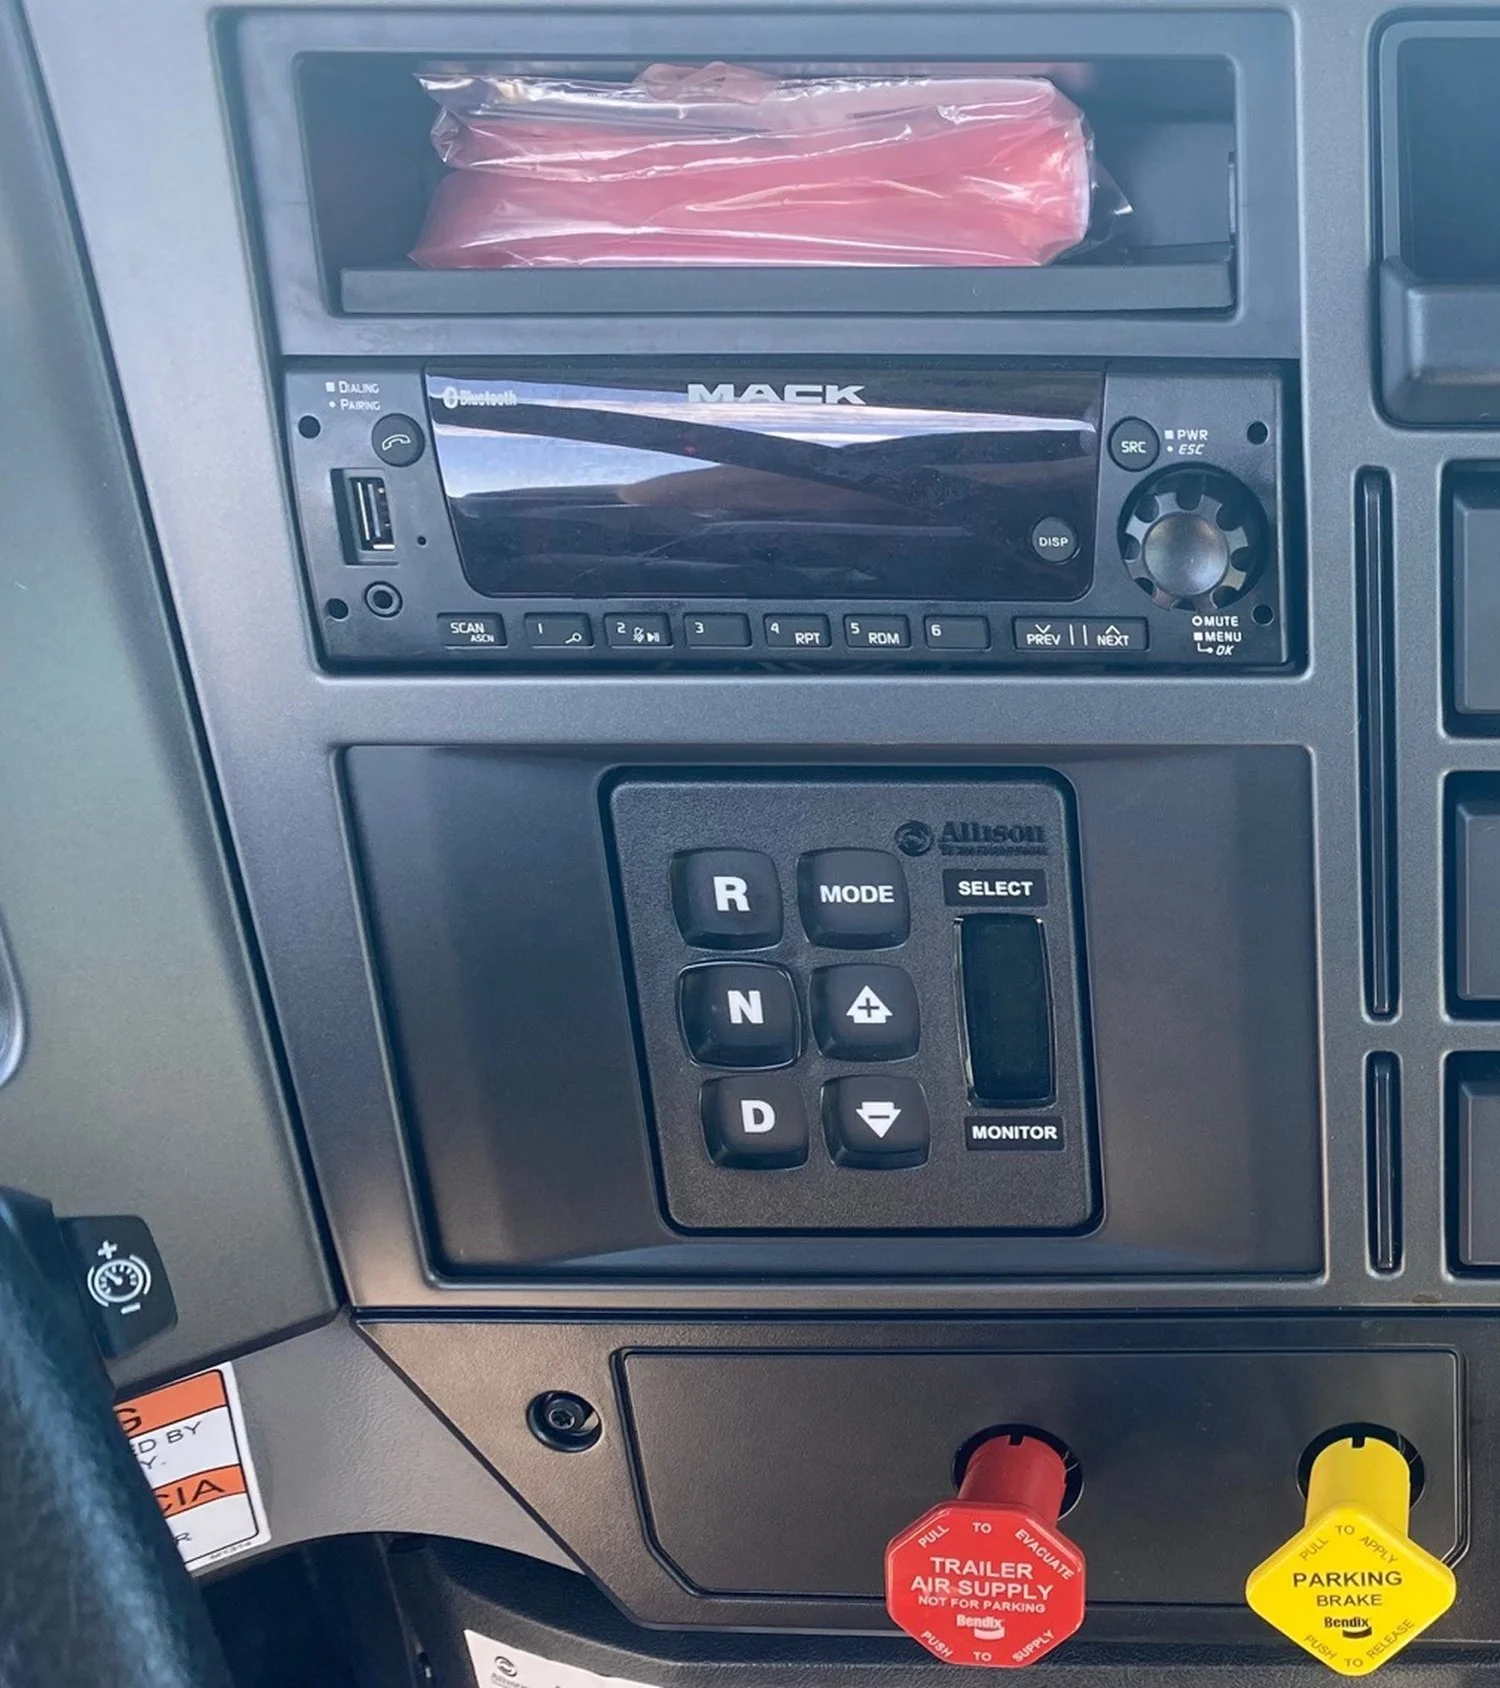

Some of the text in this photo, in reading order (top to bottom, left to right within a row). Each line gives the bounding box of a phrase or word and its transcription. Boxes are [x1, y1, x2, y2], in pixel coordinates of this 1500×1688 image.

[687, 384, 867, 405] MACK
[1177, 429, 1208, 441] PWR
[1121, 440, 1147, 454] SRC
[1178, 443, 1205, 455] ESC
[1039, 535, 1069, 548] DISP
[450, 622, 485, 634] SCAN
[616, 622, 627, 634] 2
[695, 622, 704, 634] 3
[1204, 616, 1239, 627] MUTE
[770, 622, 821, 645] 4 RPT
[850, 622, 900, 645] 5 RDM
[931, 624, 942, 637] 6
[1205, 632, 1242, 643] MENU
[1026, 634, 1061, 646] PREV
[1097, 635, 1130, 646] NEXT
[942, 821, 1046, 843] Allison
[713, 876, 750, 911] R
[820, 885, 895, 903] MODE
[958, 881, 1033, 896] SELECT
[727, 991, 764, 1024] N
[740, 1100, 776, 1133] D
[972, 1125, 1058, 1140] MONITOR
[166, 1420, 202, 1444] BY
[918, 1522, 1075, 1580] PULL TO EVACUATE
[1299, 1525, 1399, 1564] PULL TO APPLY
[930, 1557, 1034, 1580] TRAILER
[1293, 1571, 1402, 1588] PARKING
[911, 1576, 1054, 1601] AIR SUPPLY
[918, 1595, 1046, 1614] NOT FOR PARKING
[1316, 1594, 1382, 1607] BRAKE
[956, 1614, 1002, 1630] Bendix
[1324, 1617, 1369, 1628] Bendix
[921, 1629, 1055, 1662] PUSH TO SUPPLY
[1304, 1619, 1415, 1668] PUSH TO RELEASE
